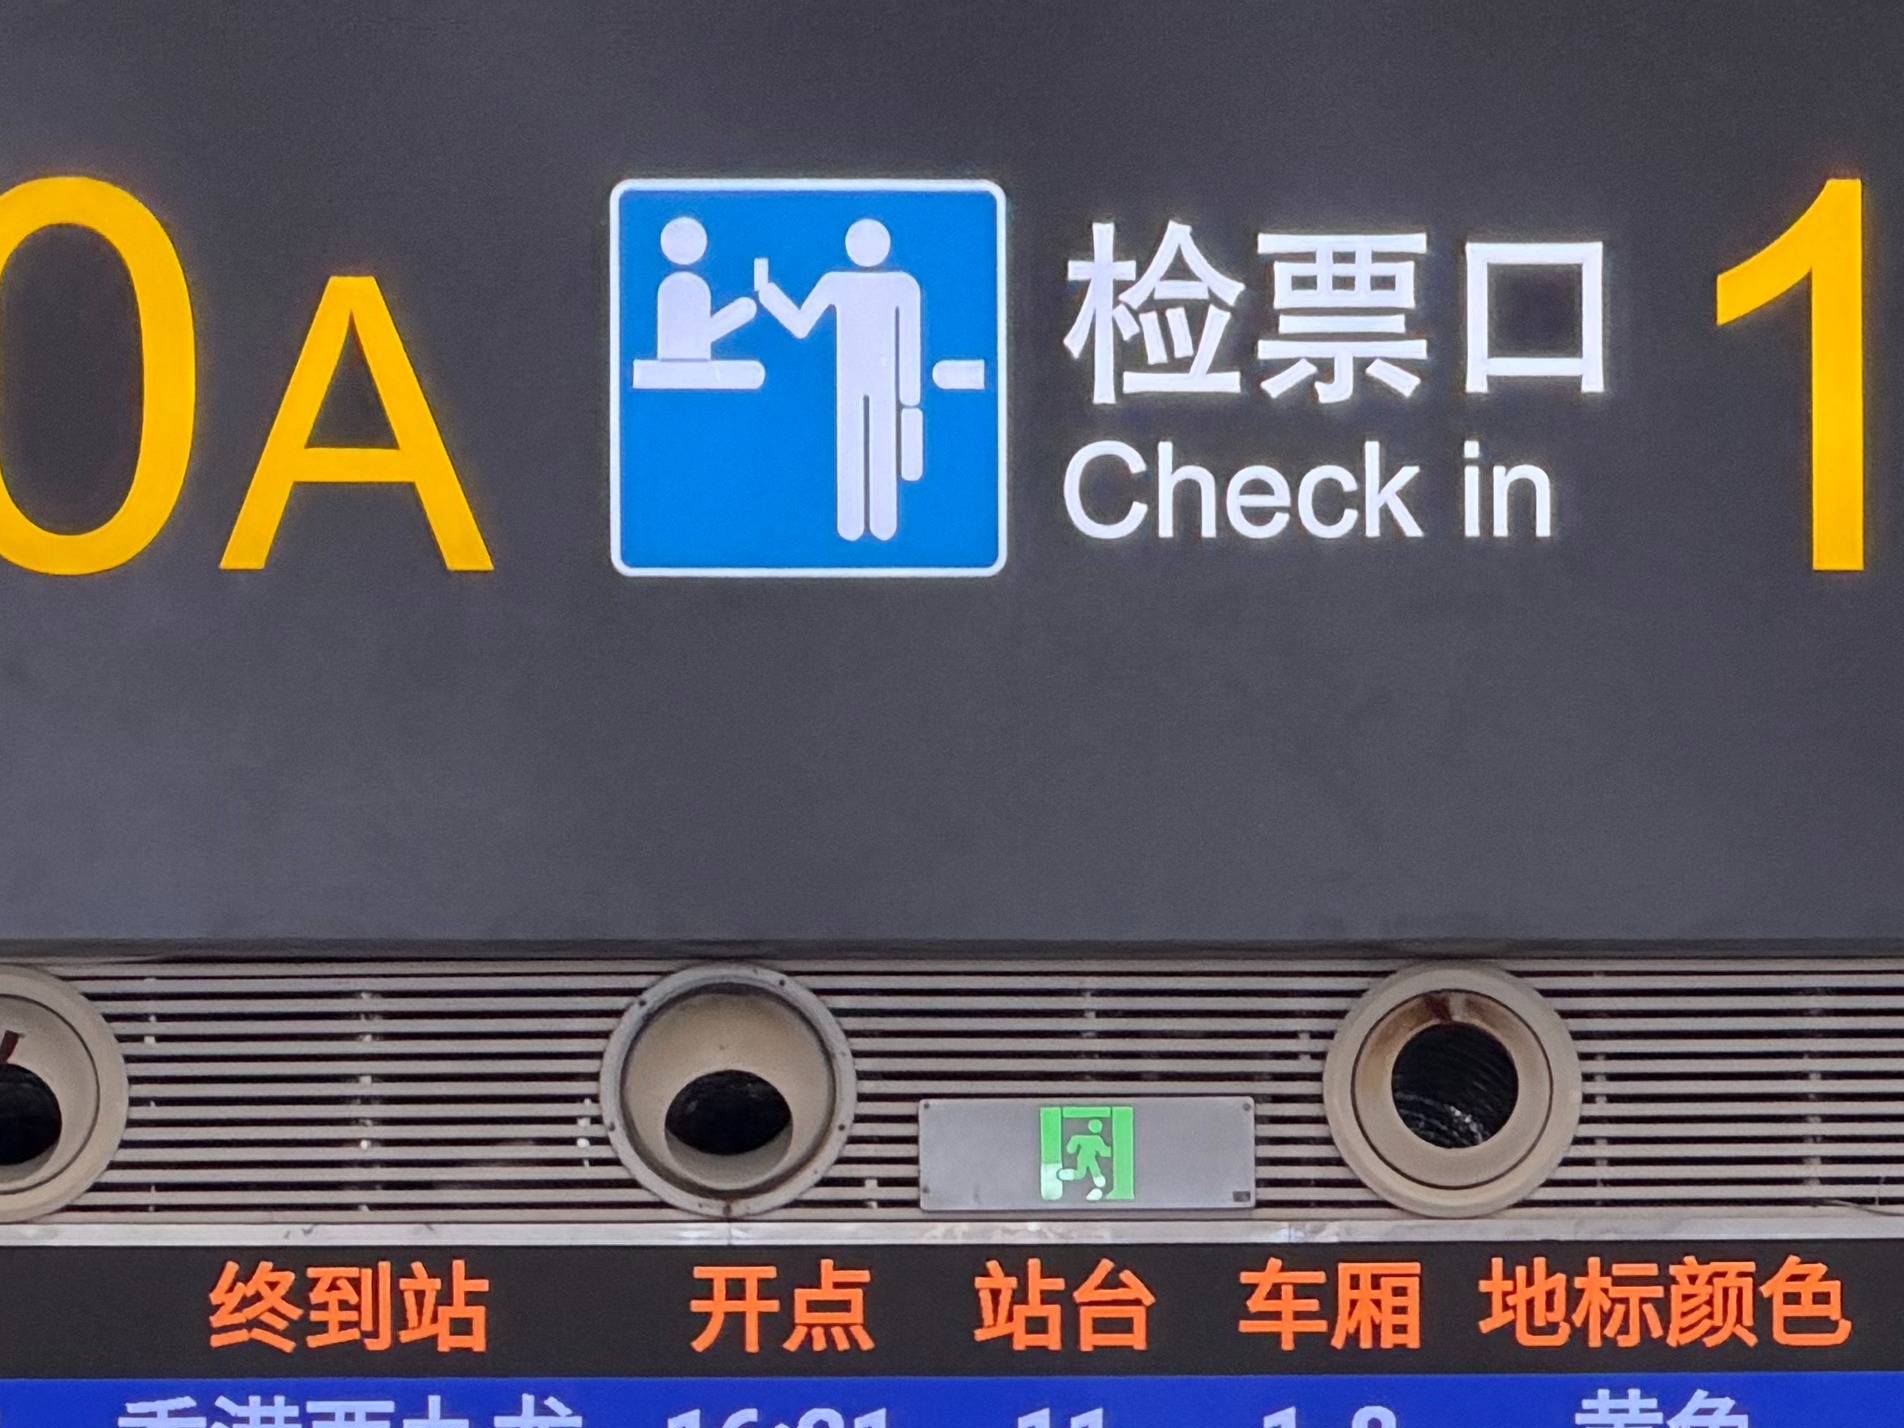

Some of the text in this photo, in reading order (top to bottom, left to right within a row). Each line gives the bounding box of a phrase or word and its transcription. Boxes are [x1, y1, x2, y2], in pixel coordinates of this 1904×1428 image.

[1064, 220, 1605, 404] 检票口
[1064, 440, 1551, 539] Check in
[209, 1259, 489, 1353] 终到站
[690, 1259, 875, 1353] 开点
[974, 1258, 1156, 1352] 站台
[1238, 1257, 1421, 1351] 车厢
[1478, 1255, 1852, 1348] 地标颜色
